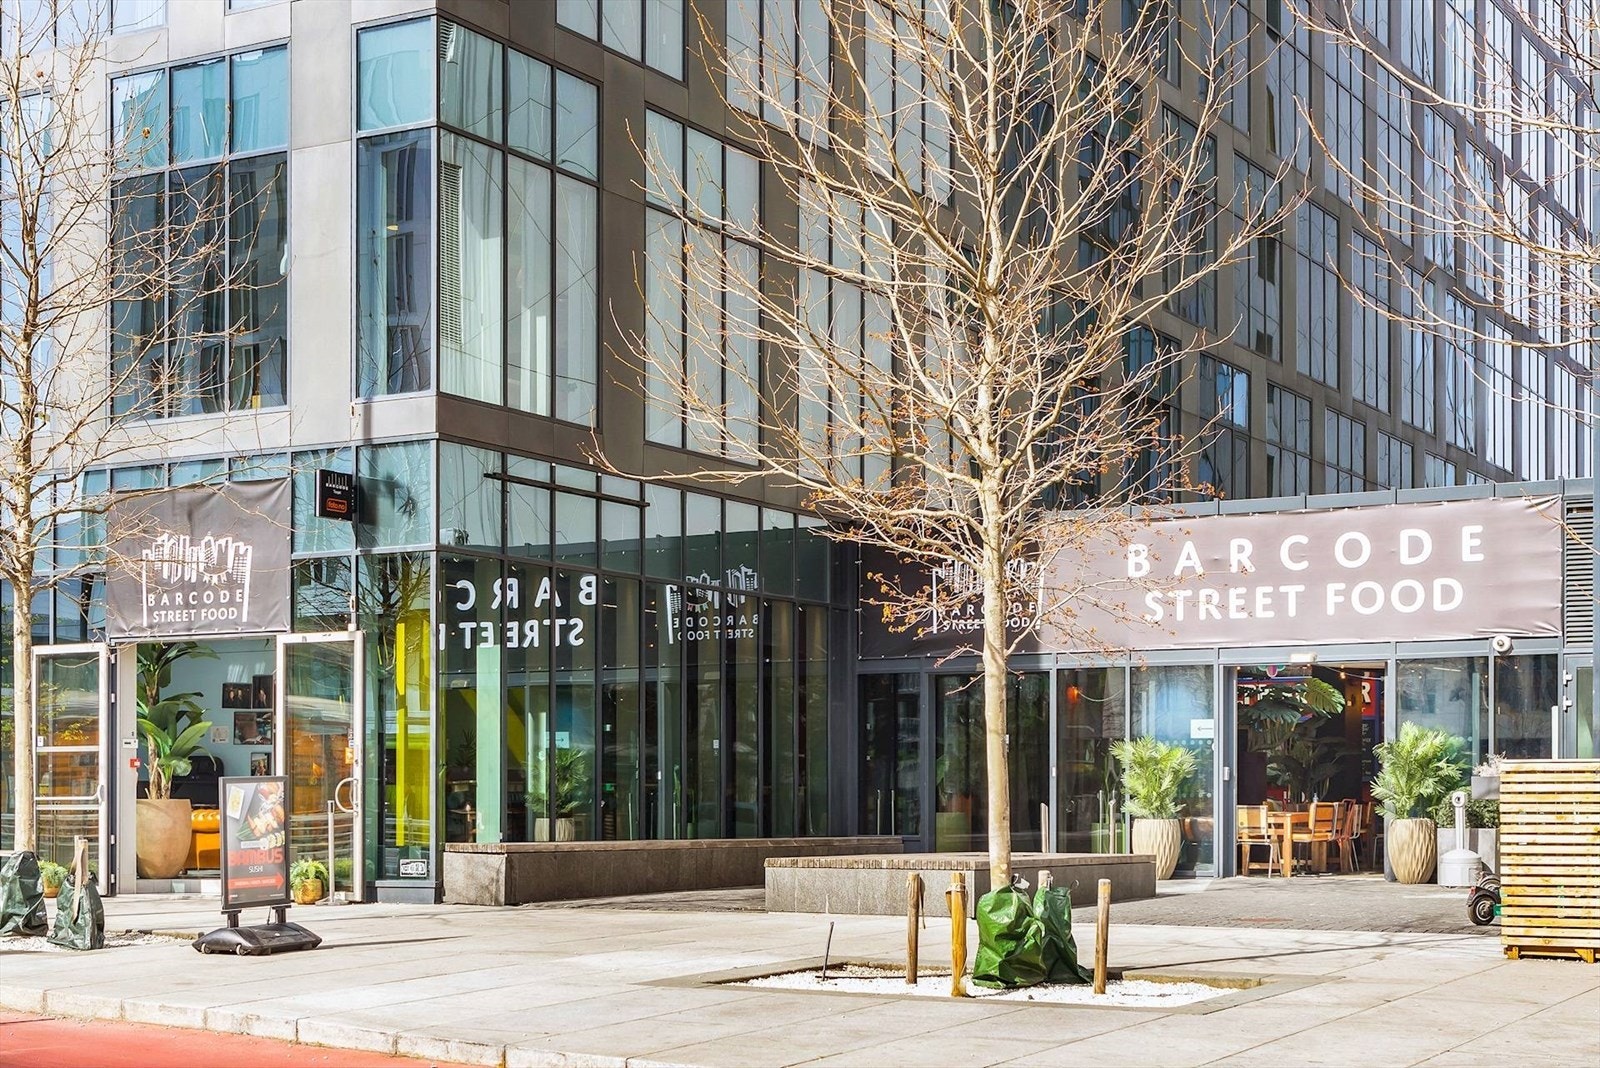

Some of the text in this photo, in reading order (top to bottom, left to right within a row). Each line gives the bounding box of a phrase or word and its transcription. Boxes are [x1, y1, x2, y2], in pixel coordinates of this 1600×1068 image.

[1127, 525, 1484, 578] BARCODE
[148, 589, 243, 606] BARCODE
[1144, 577, 1464, 622] STREET FOOD
[153, 607, 238, 623] STREET FOOD
[248, 865, 264, 874] SUSHI
